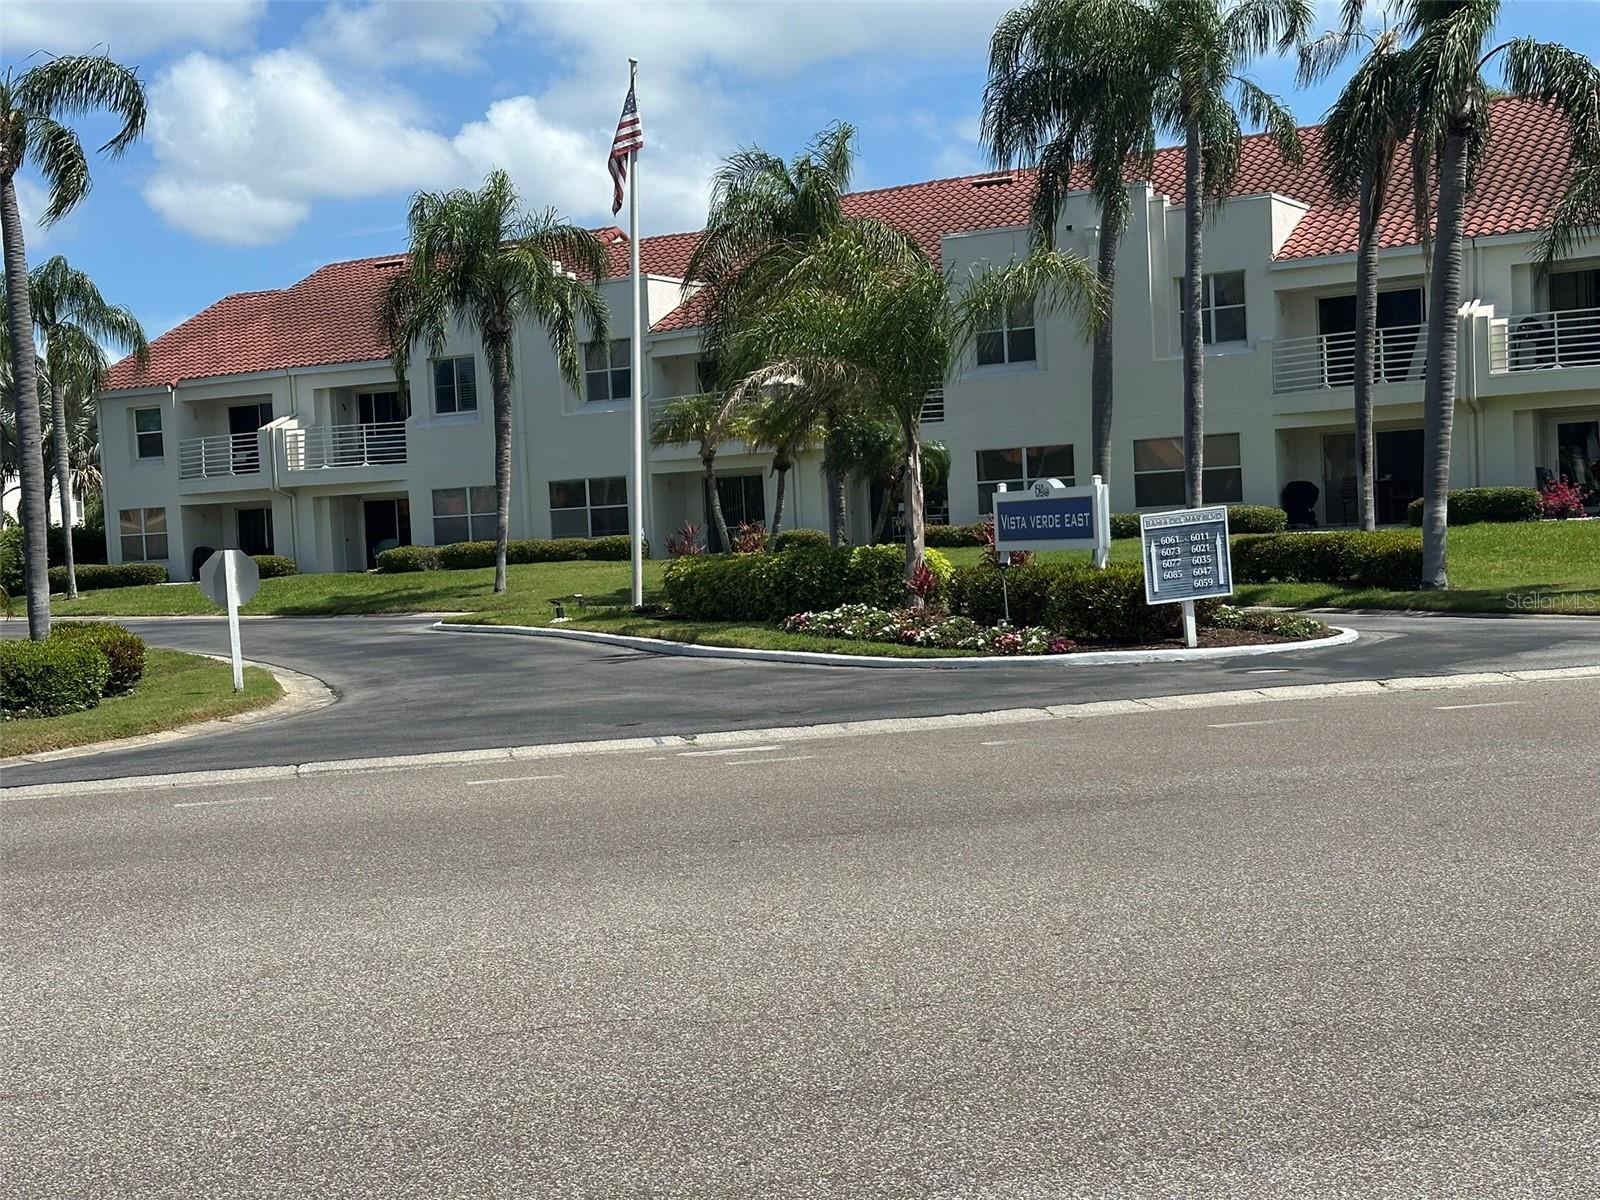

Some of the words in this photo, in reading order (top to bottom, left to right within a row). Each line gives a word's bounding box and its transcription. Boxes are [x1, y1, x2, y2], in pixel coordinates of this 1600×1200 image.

[1001, 514, 1027, 530] VISTA
[1029, 514, 1060, 529] VERDE
[1065, 512, 1090, 527] EAST
[1160, 535, 1179, 545] 6061
[1190, 532, 1209, 541] 6011
[1161, 547, 1181, 556] 6073
[1191, 543, 1210, 553] 6021
[1162, 559, 1181, 568] 6077
[1192, 555, 1211, 564] 6035
[1163, 570, 1182, 579] 6085
[1193, 567, 1212, 576] 6047
[1194, 578, 1213, 587] 6059
